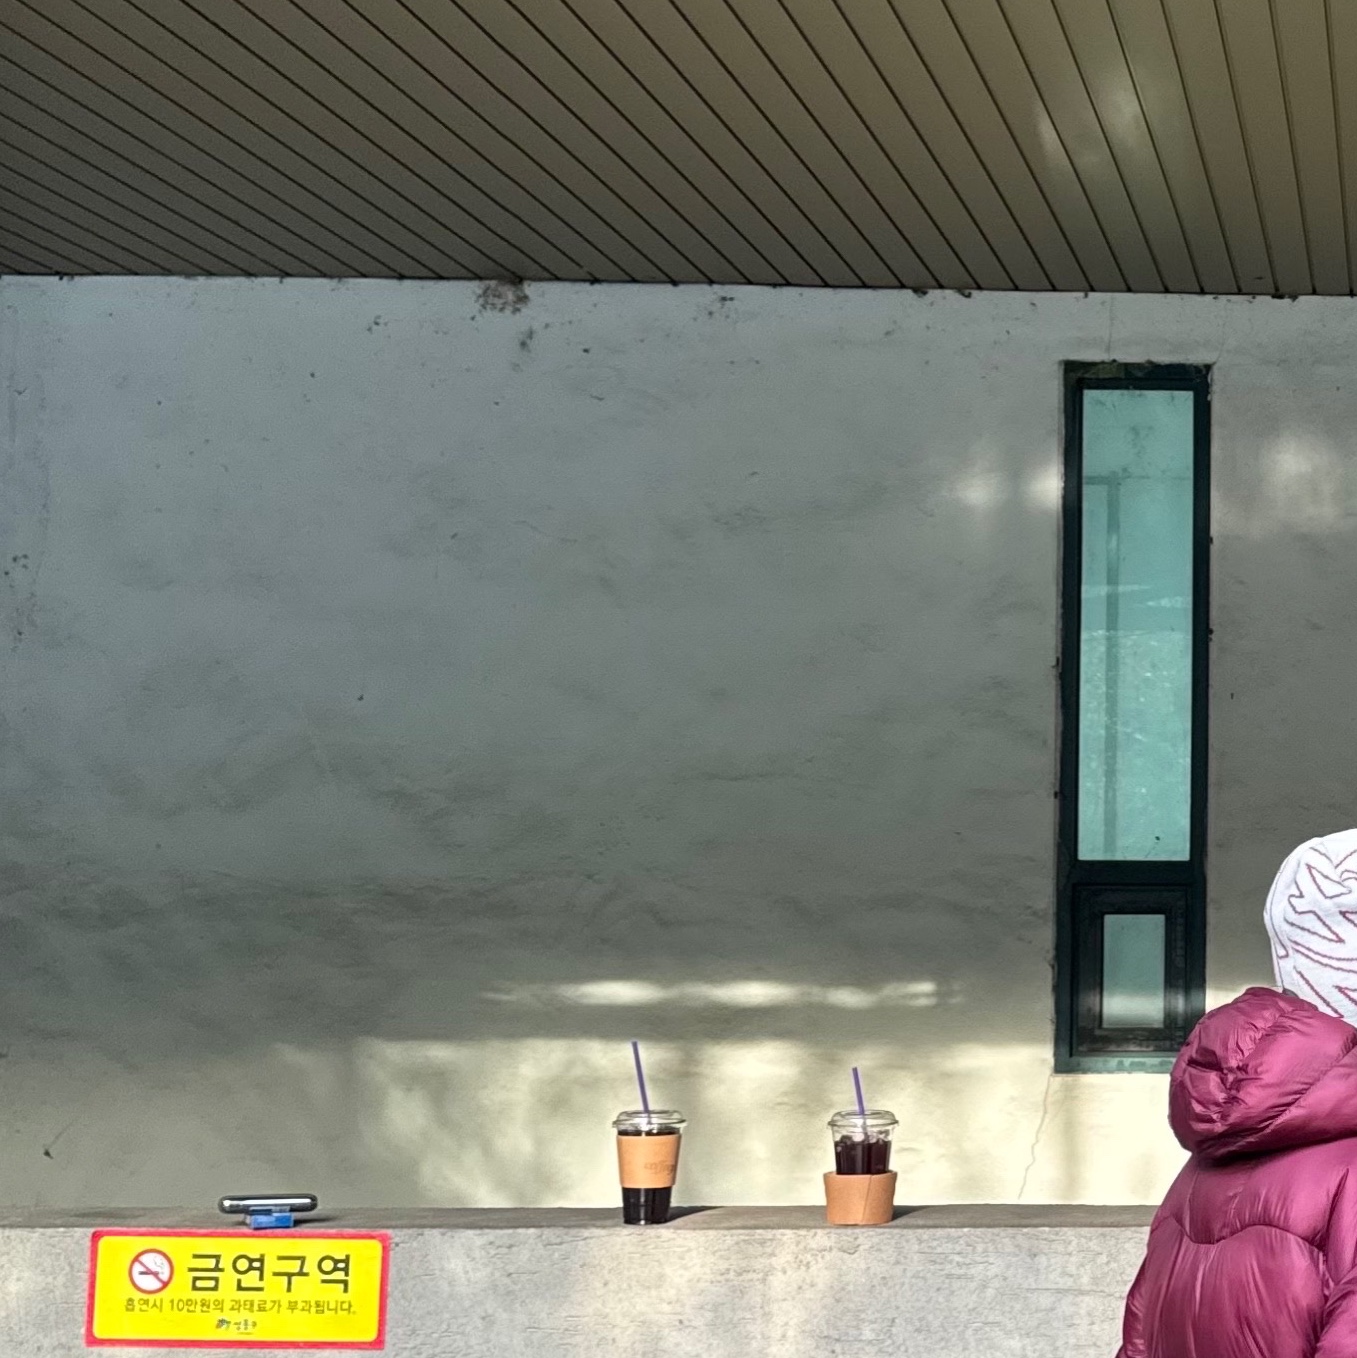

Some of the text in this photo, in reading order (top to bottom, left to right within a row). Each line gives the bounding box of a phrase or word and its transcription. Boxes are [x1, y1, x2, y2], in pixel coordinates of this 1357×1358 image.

[187, 1253, 351, 1294] 금연구역
[124, 1298, 357, 1317] 흡연시 10만원의 과태료가 부과됩니다.
